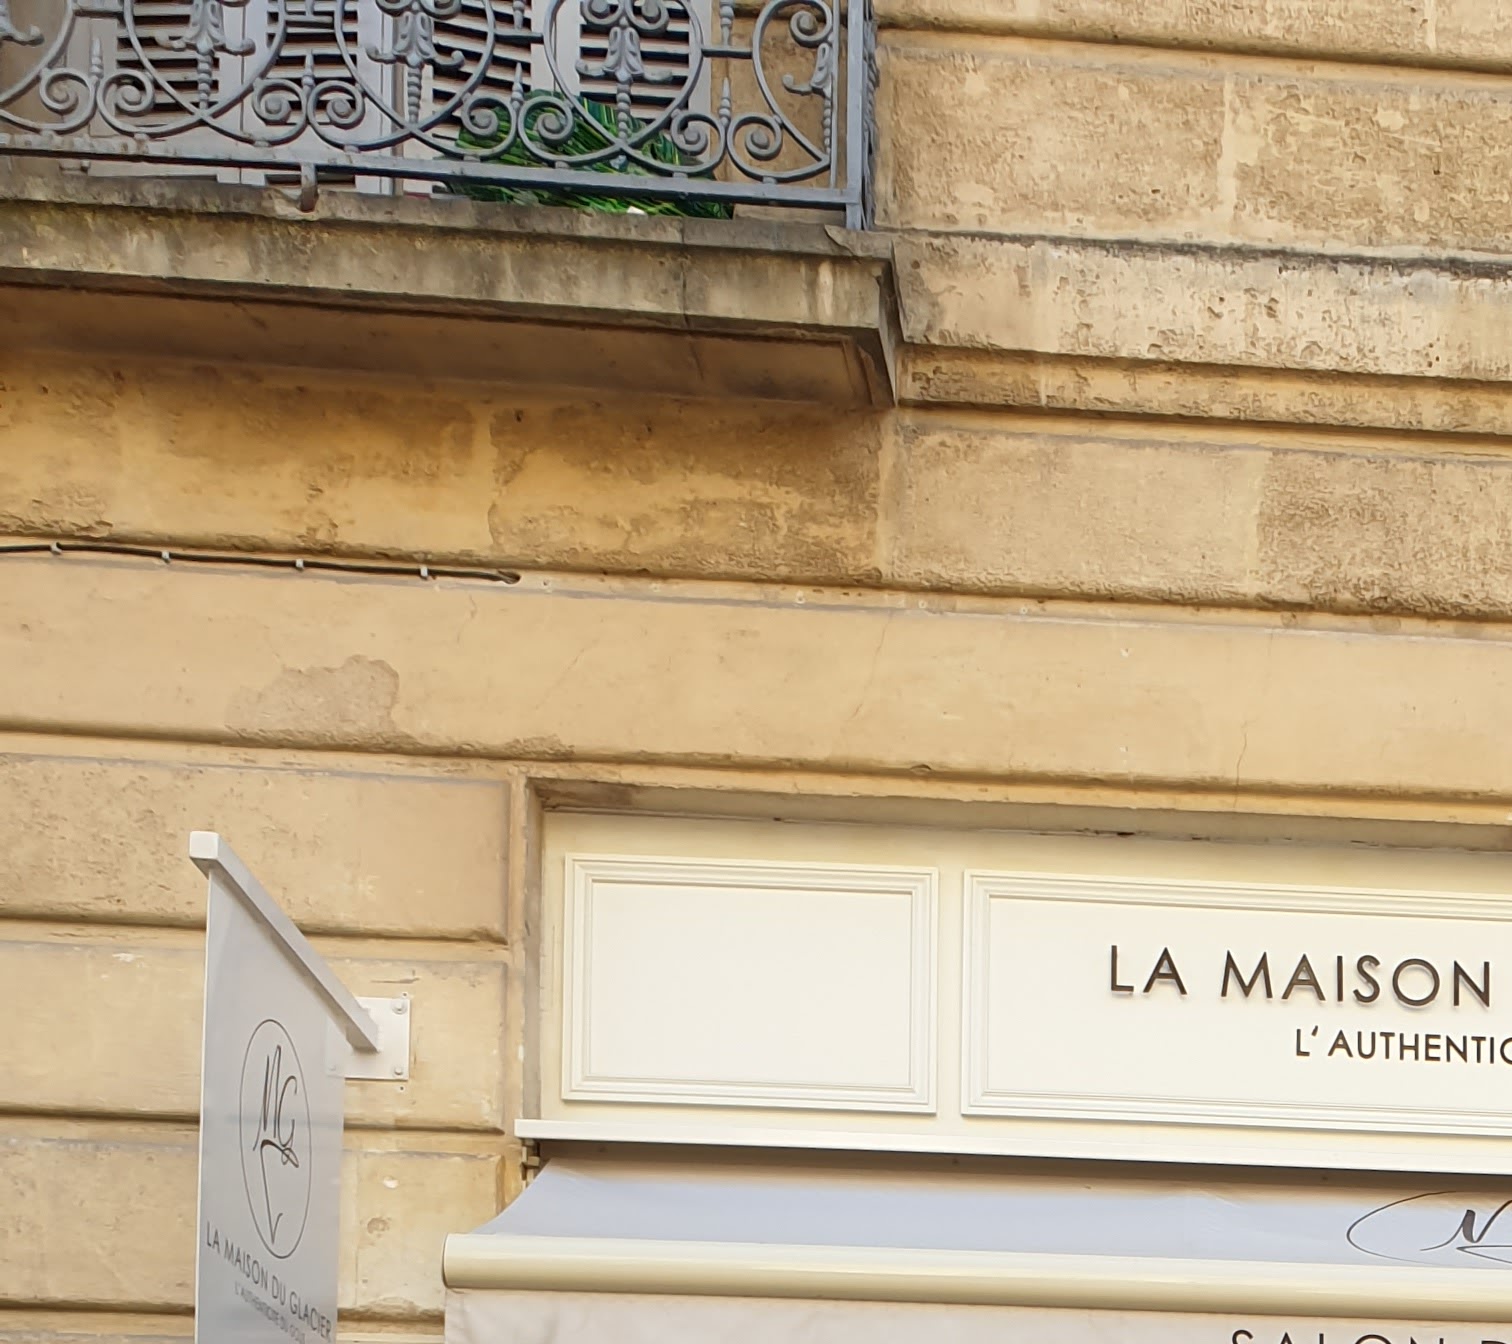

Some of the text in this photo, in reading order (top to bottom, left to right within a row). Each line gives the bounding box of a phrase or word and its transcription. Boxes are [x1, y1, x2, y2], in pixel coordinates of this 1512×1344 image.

[1110, 944, 1188, 996] LA
[1220, 949, 1491, 1009] MAISON
[206, 1220, 332, 1343] LA MAISON DU GLACIER
